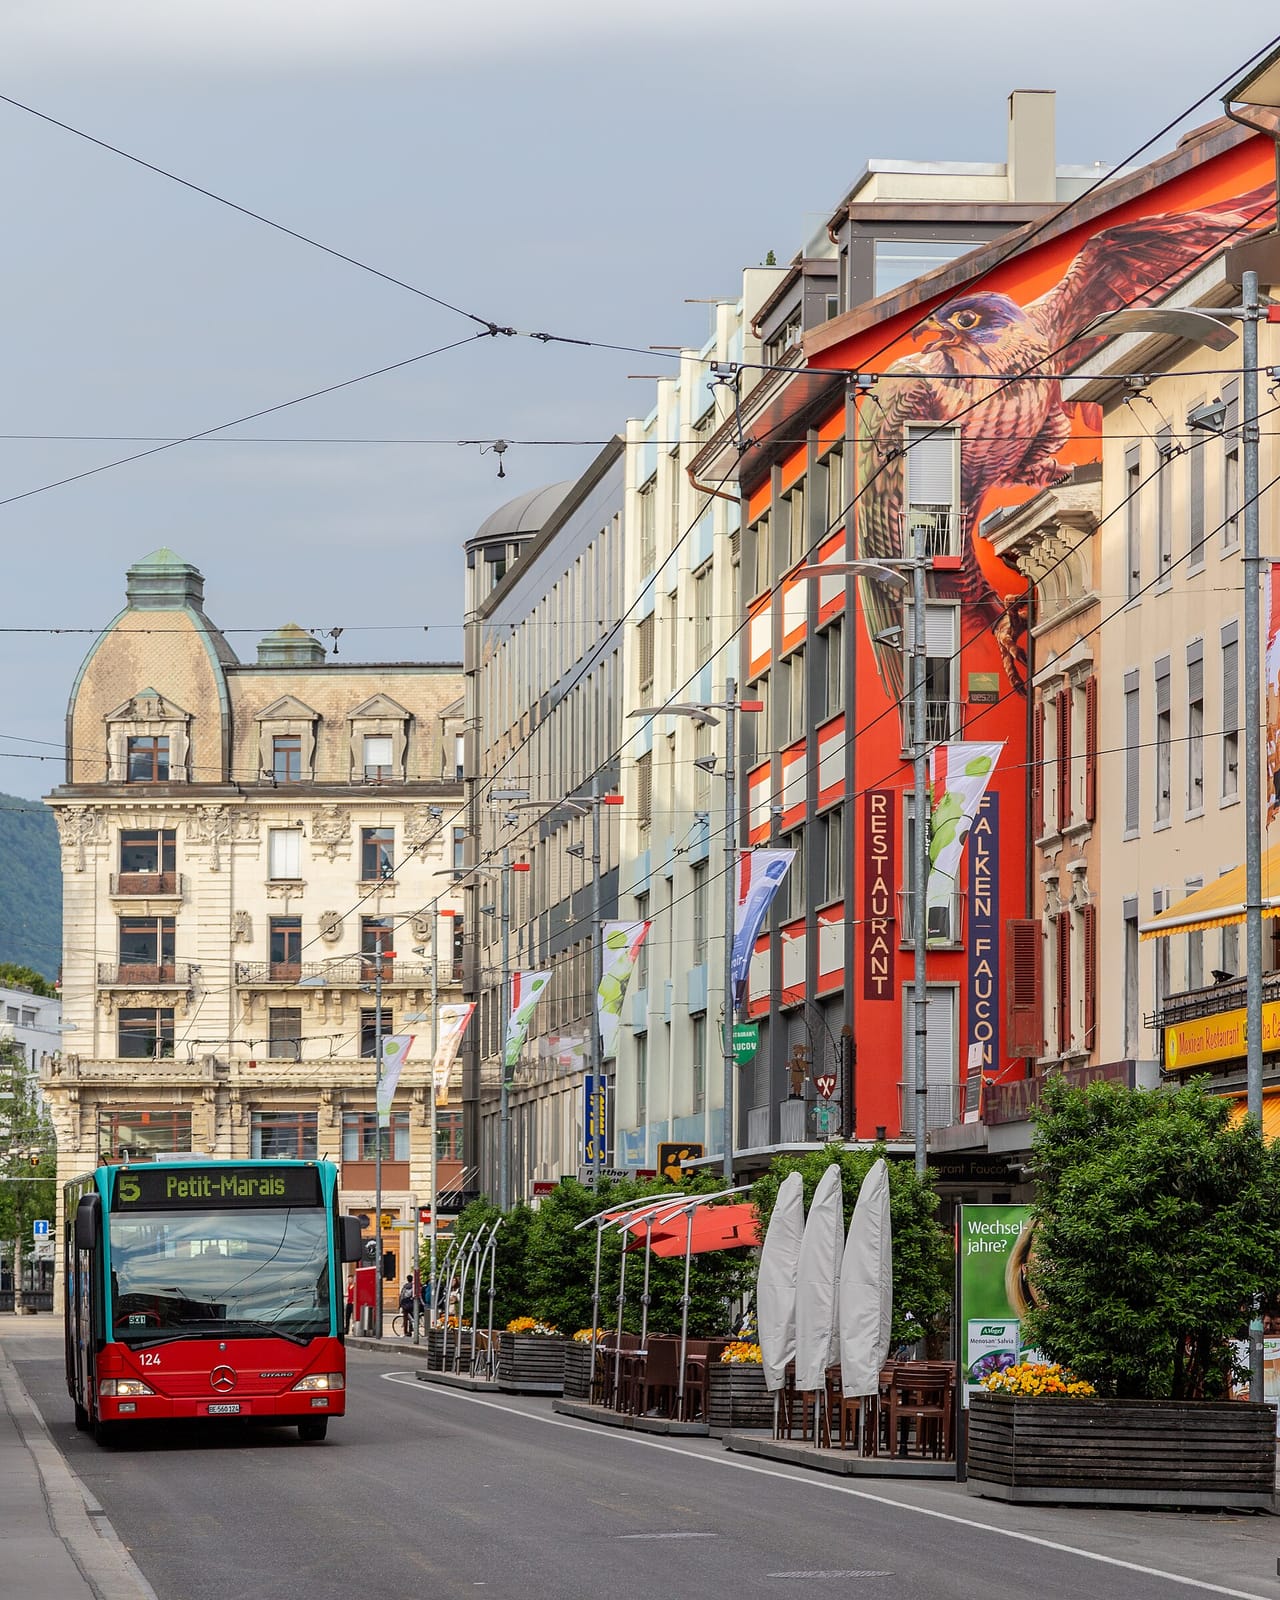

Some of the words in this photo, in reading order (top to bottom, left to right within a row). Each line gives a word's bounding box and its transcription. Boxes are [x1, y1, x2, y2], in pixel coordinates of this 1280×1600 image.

[974, 795, 992, 917] FALKEN
[870, 794, 889, 994] RESTAURANT
[974, 938, 993, 1065] FAUCON
[1179, 1032, 1204, 1056] Mexican
[1205, 1022, 1239, 1050] Restaurant
[119, 1175, 141, 1201] 5
[166, 1174, 285, 1198] Petit-Marais
[967, 1219, 1028, 1235] Wechsel-
[967, 1237, 1008, 1256] jahre?
[139, 1353, 161, 1366] 124
